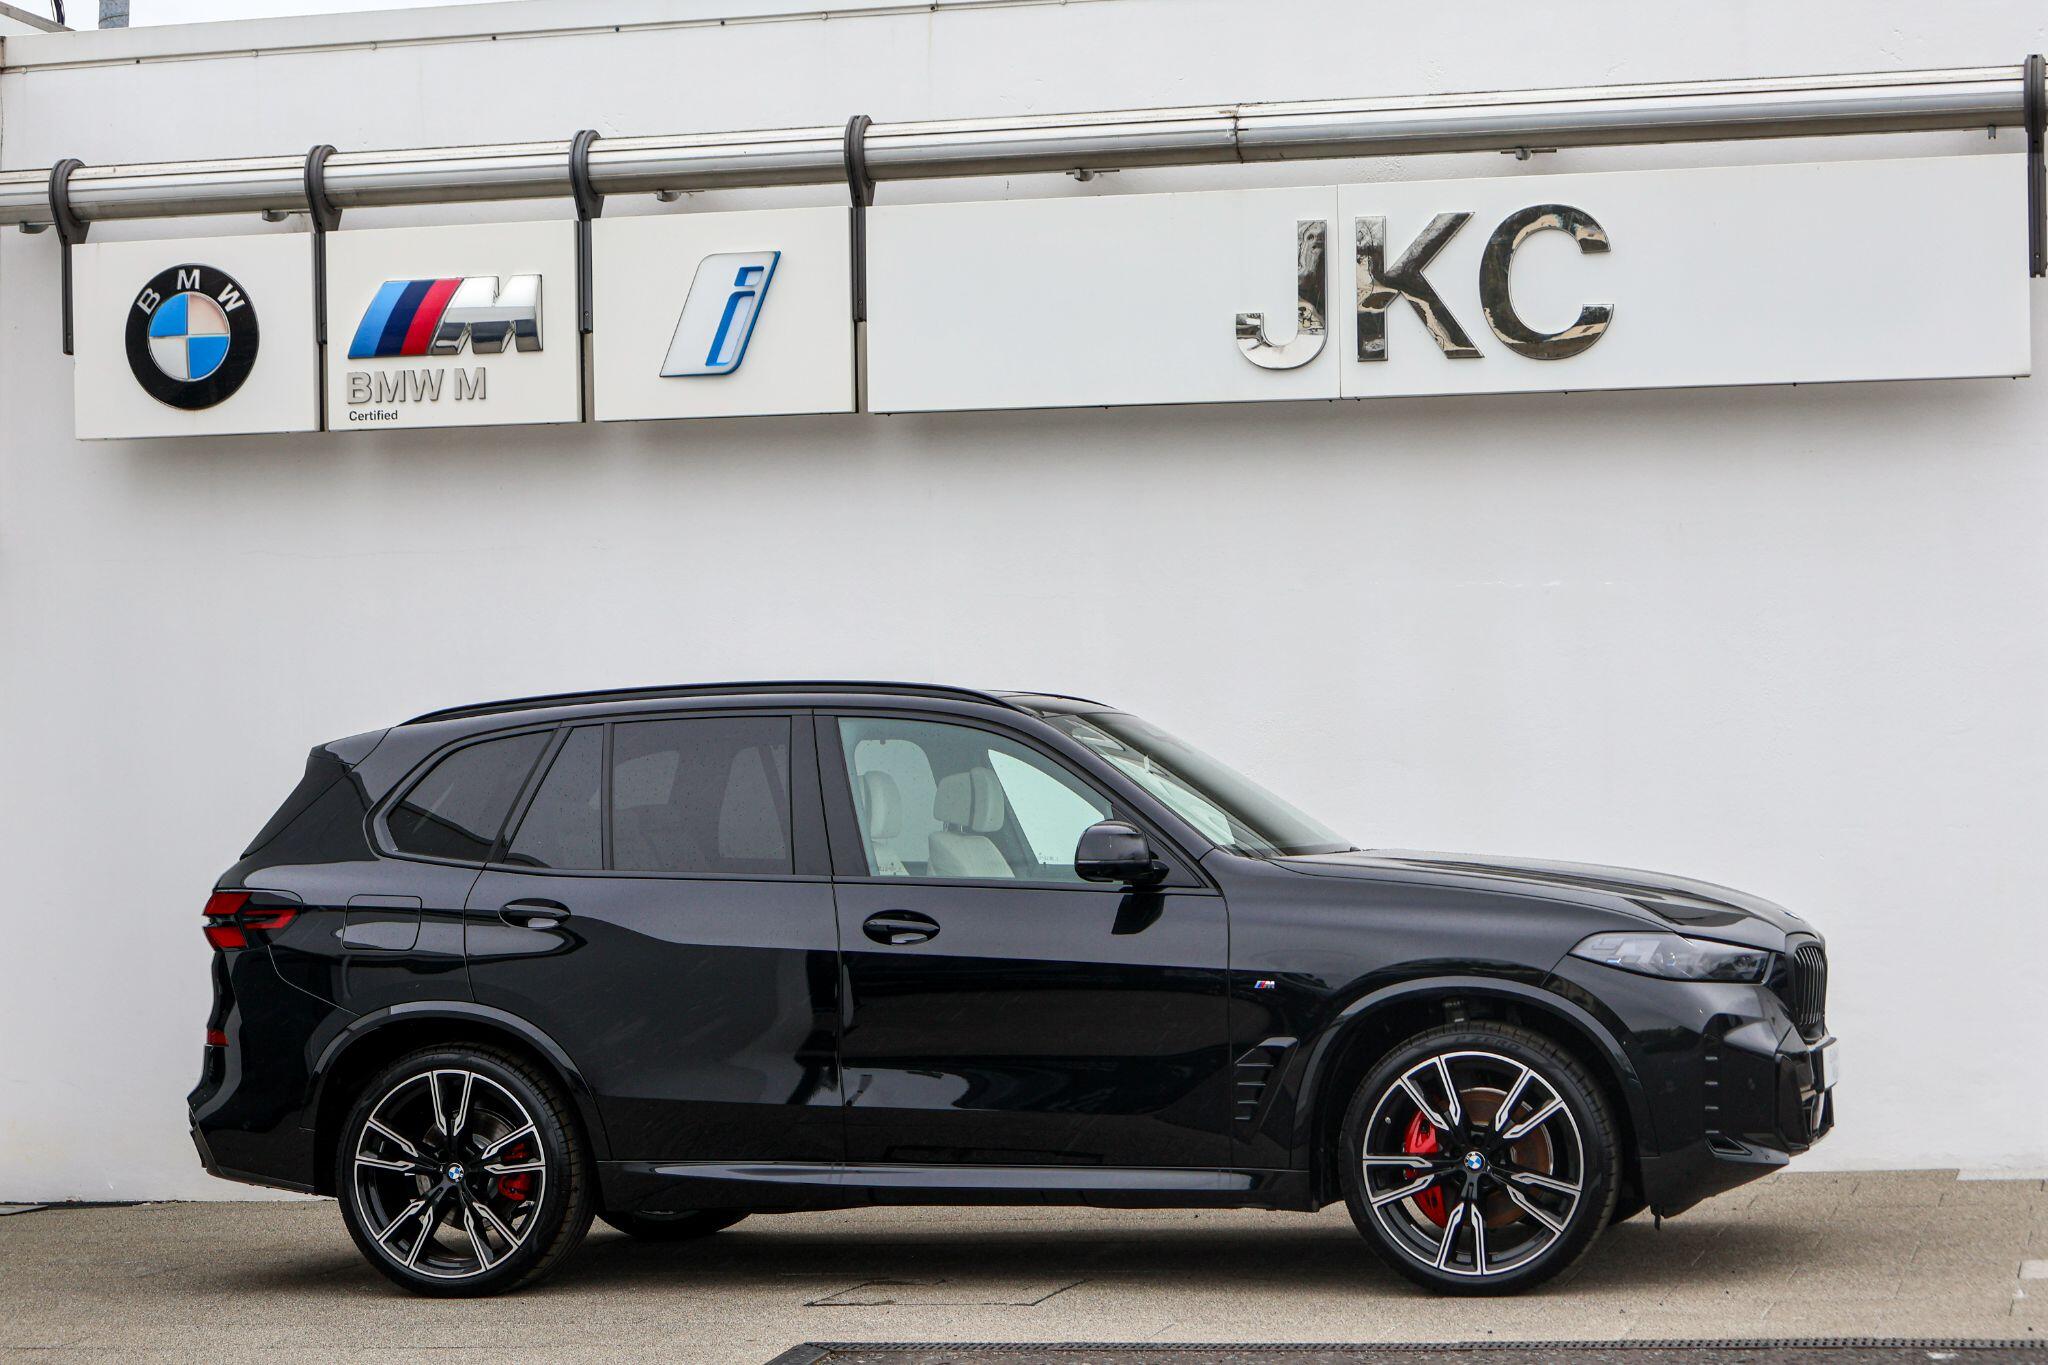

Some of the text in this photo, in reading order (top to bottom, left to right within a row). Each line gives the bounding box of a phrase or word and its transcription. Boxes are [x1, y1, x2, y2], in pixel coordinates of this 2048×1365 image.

[137, 268, 246, 316] BMW
[428, 273, 544, 355] M
[705, 265, 765, 367] i
[1235, 203, 1615, 371] JKC
[346, 366, 487, 405] BMW M
[349, 409, 399, 422] Certified
